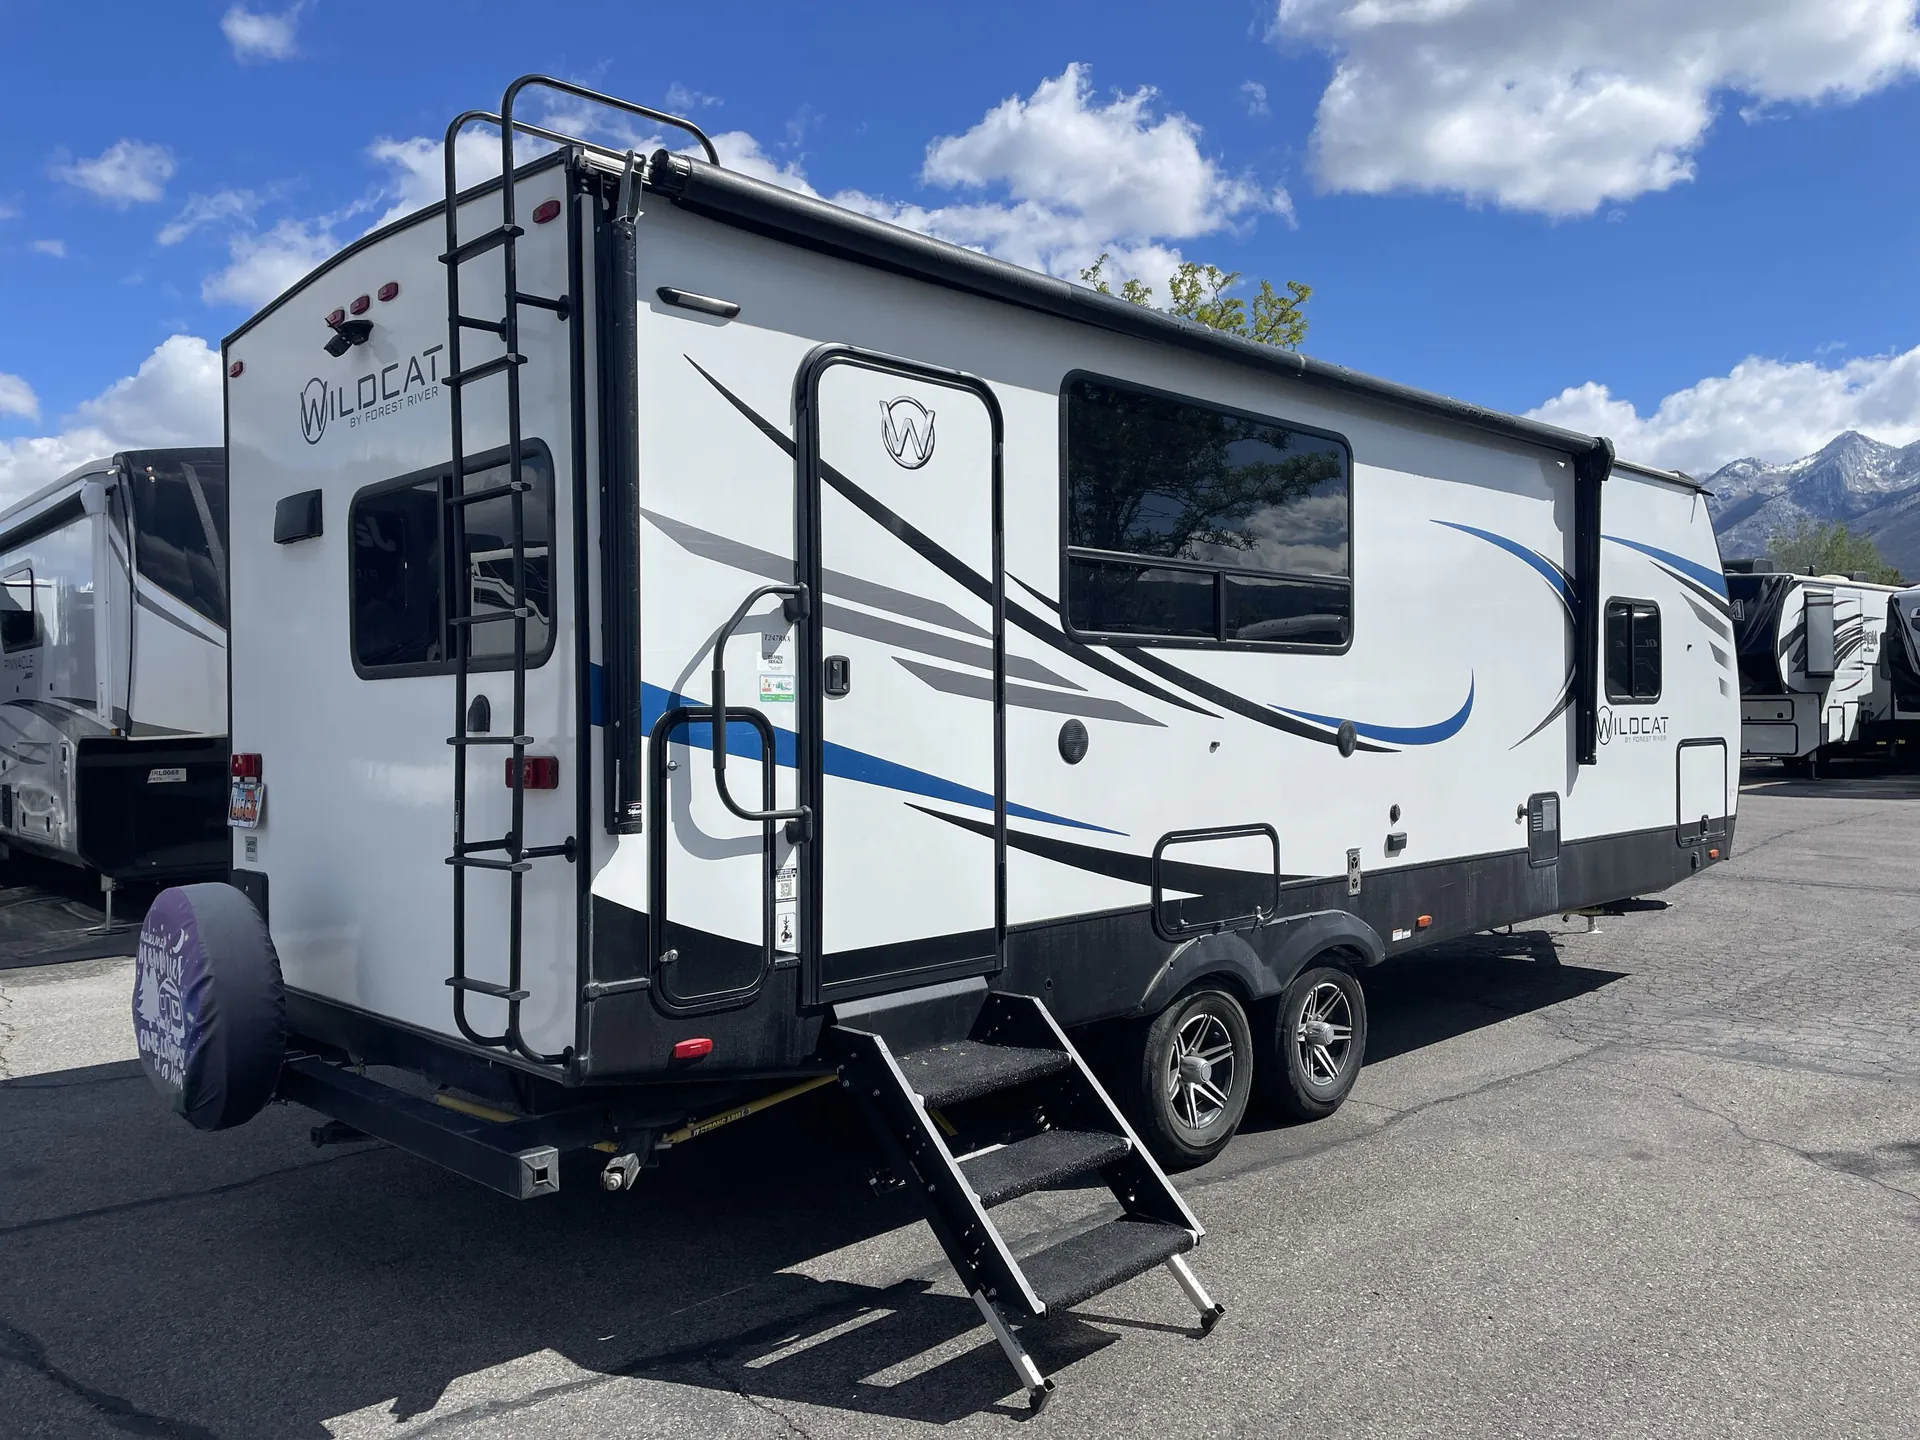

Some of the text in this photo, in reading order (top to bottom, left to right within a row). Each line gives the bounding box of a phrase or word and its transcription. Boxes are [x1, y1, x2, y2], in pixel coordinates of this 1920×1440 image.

[300, 344, 443, 445] WILDCAT
[350, 386, 439, 428] BY FOREST RIVER
[1596, 706, 1669, 745] WILDCAT
